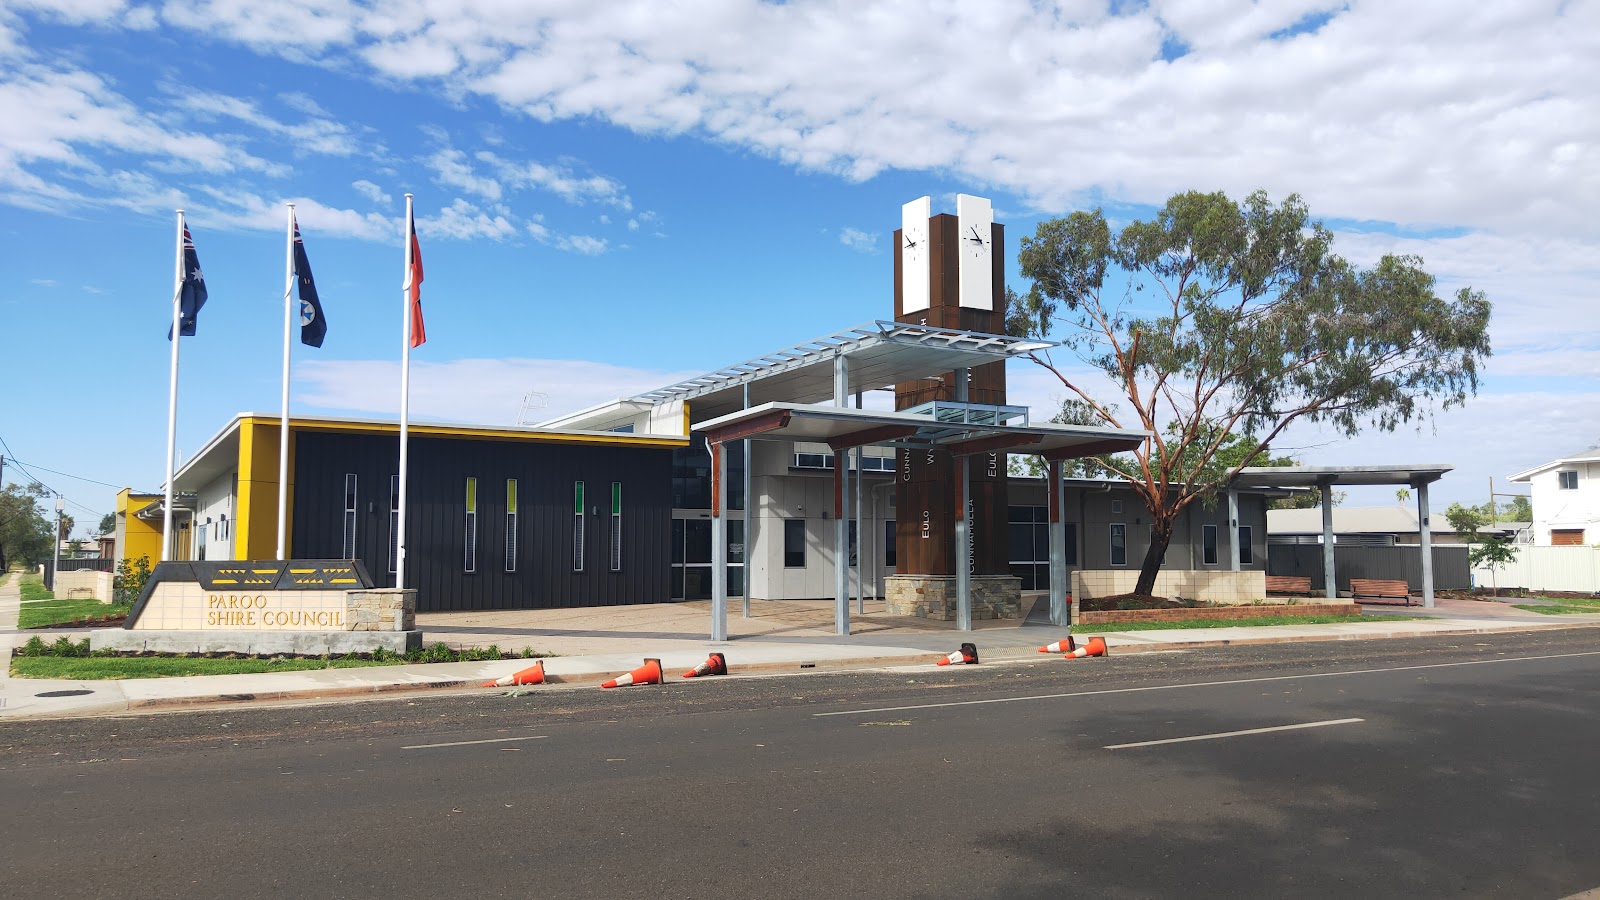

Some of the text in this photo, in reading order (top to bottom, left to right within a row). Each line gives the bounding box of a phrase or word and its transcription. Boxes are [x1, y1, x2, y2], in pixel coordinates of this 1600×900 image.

[922, 510, 930, 539] EULO
[208, 594, 267, 609] PAROO
[207, 611, 344, 626] SHIRE COUNCIL
